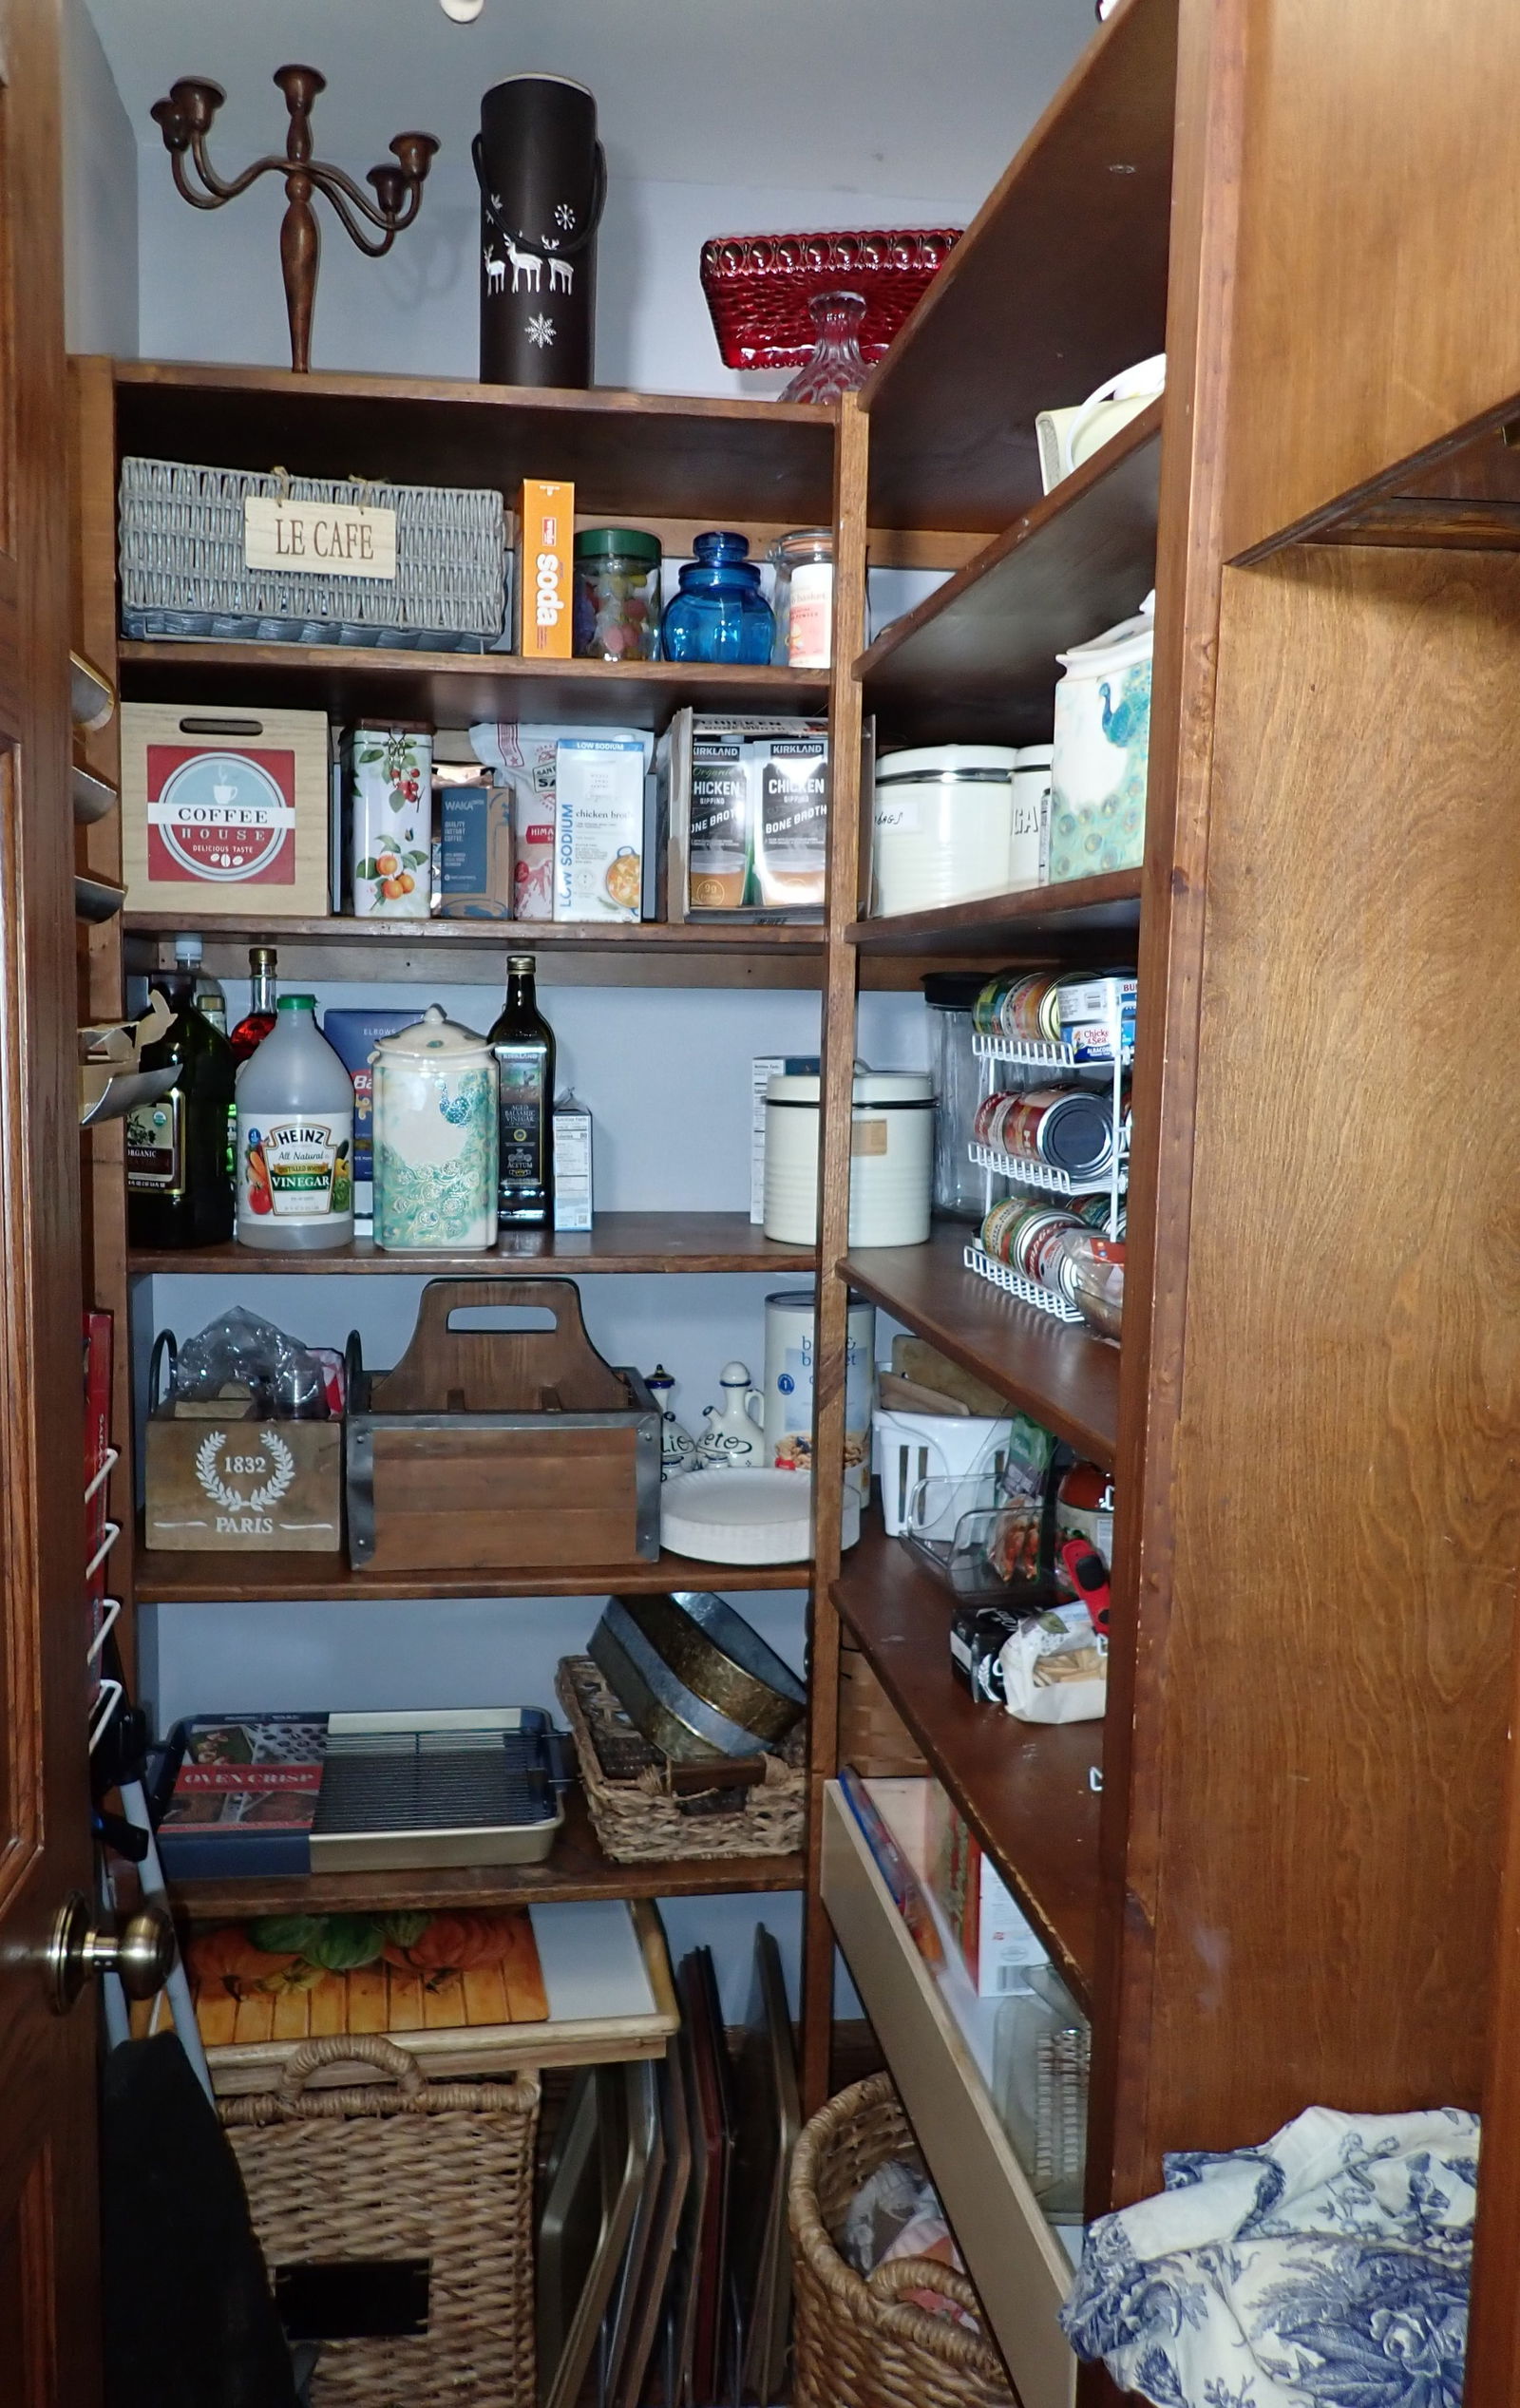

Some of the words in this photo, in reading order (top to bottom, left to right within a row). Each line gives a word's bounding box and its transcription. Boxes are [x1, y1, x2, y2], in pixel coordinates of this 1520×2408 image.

[276, 519, 306, 556] LE
[314, 521, 374, 560] CAFE
[537, 553, 564, 626] soda
[773, 746, 823, 754] KIRKLAND
[694, 781, 740, 796] HICKEN
[769, 779, 825, 794] CHICKEN
[445, 801, 474, 811] WAKA
[576, 808, 608, 819] chicken
[178, 807, 268, 824] COFFEE
[765, 818, 791, 835] BONE
[793, 805, 827, 825] BROTH
[181, 827, 265, 842] HOUSE
[561, 804, 574, 866] SODIUM
[193, 844, 229, 853] DELICIOUS
[233, 845, 254, 854] TASTE
[278, 1128, 325, 1146] HEINZ
[278, 1151, 291, 1161] All
[293, 1151, 325, 1161] Natural
[272, 1176, 331, 1187] VINEGAR
[224, 1456, 267, 1473] 1832
[216, 1516, 274, 1534] PARIS
[183, 1773, 243, 1784] OVEN
[247, 1773, 314, 1783] CRISP
